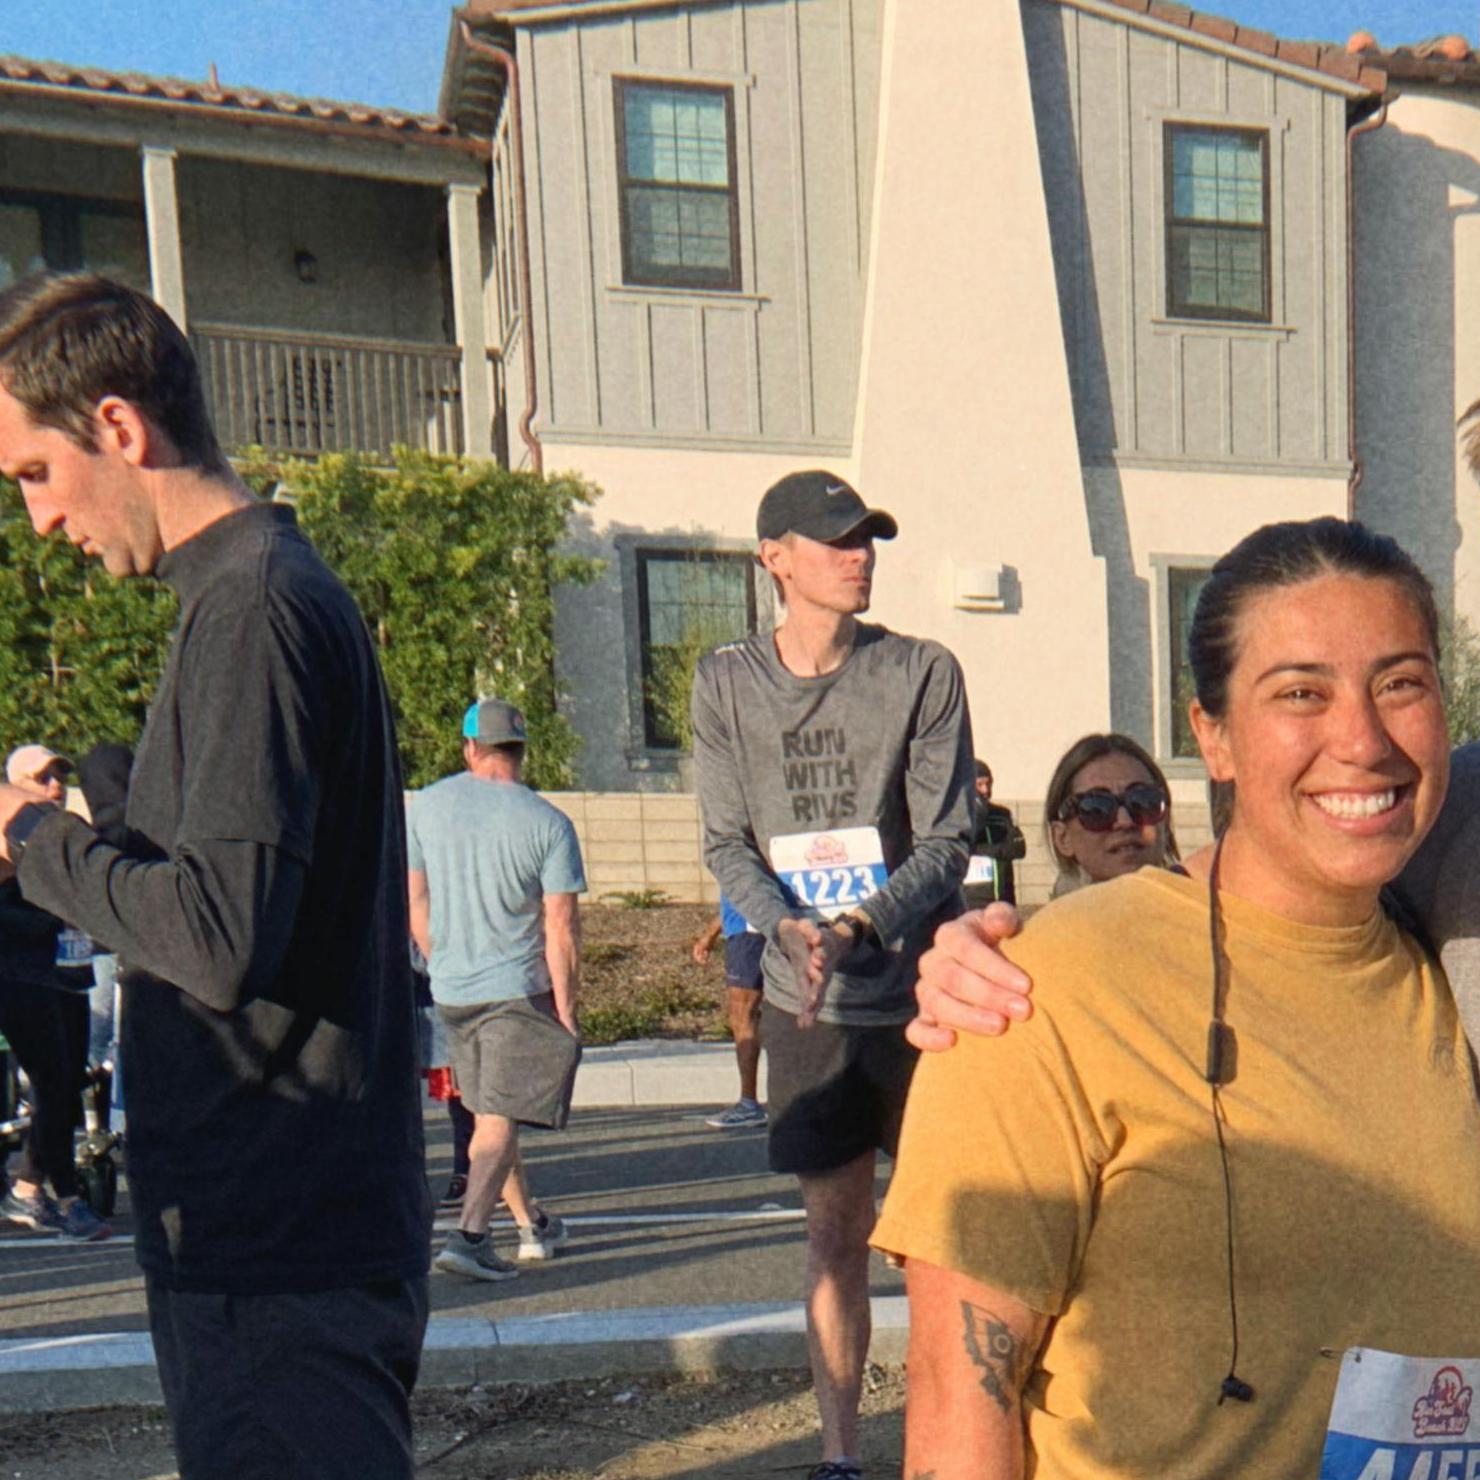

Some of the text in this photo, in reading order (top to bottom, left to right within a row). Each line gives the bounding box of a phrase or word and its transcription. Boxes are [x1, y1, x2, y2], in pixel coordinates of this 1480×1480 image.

[782, 728, 846, 758] RUN
[783, 760, 857, 791] WITH
[792, 791, 859, 822] RIVS
[791, 866, 880, 908] 1223
